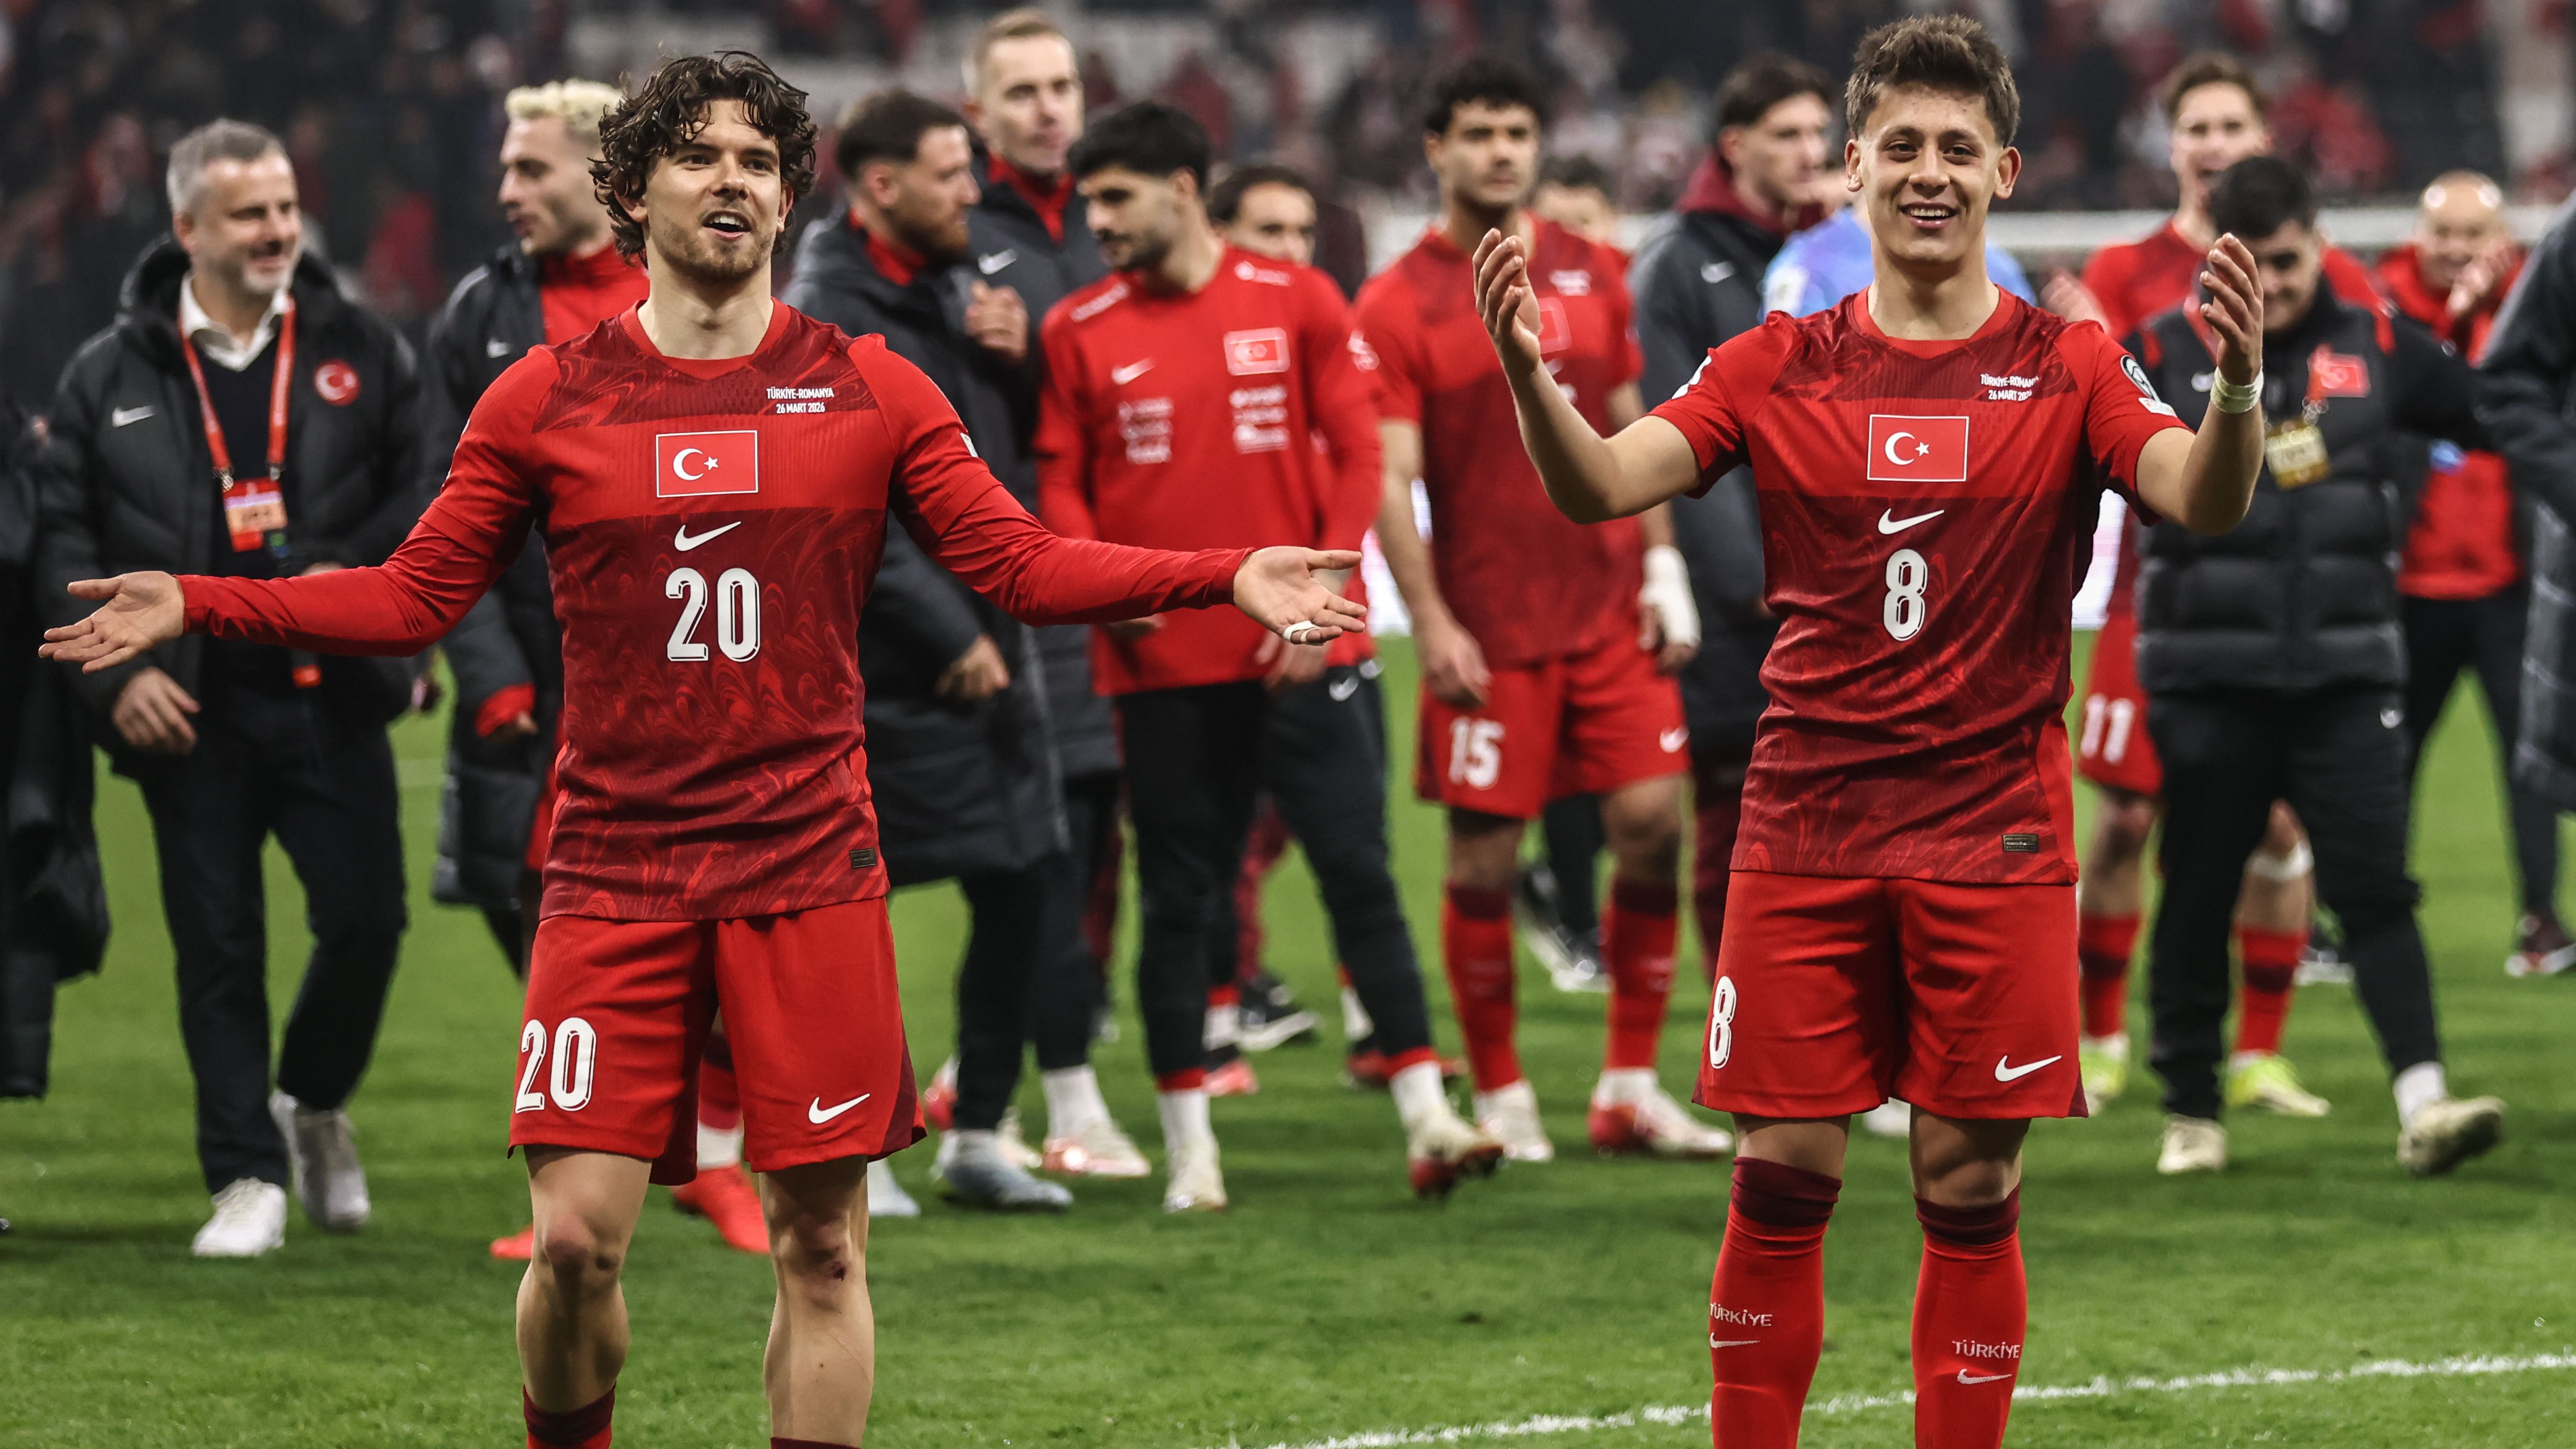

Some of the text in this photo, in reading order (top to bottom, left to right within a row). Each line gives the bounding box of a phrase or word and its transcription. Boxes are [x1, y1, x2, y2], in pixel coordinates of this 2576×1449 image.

[766, 386, 835, 399] TÜRKİYE-ROMANYA
[1980, 373, 2039, 388] TÜRKİYE-ROMAN
[1988, 389, 1997, 400] 26
[1997, 390, 2017, 401] MART
[776, 402, 825, 414] 26 MART 2026
[666, 567, 760, 662] 20
[1884, 549, 1928, 641] 8
[2080, 692, 2137, 765] 11
[1448, 716, 1505, 790] 15
[1709, 975, 1737, 1069] 8
[515, 1017, 597, 1114] 20
[1710, 1303, 1772, 1326] TÜRKİYE
[1951, 1339, 2021, 1359] TÜRKİYE
